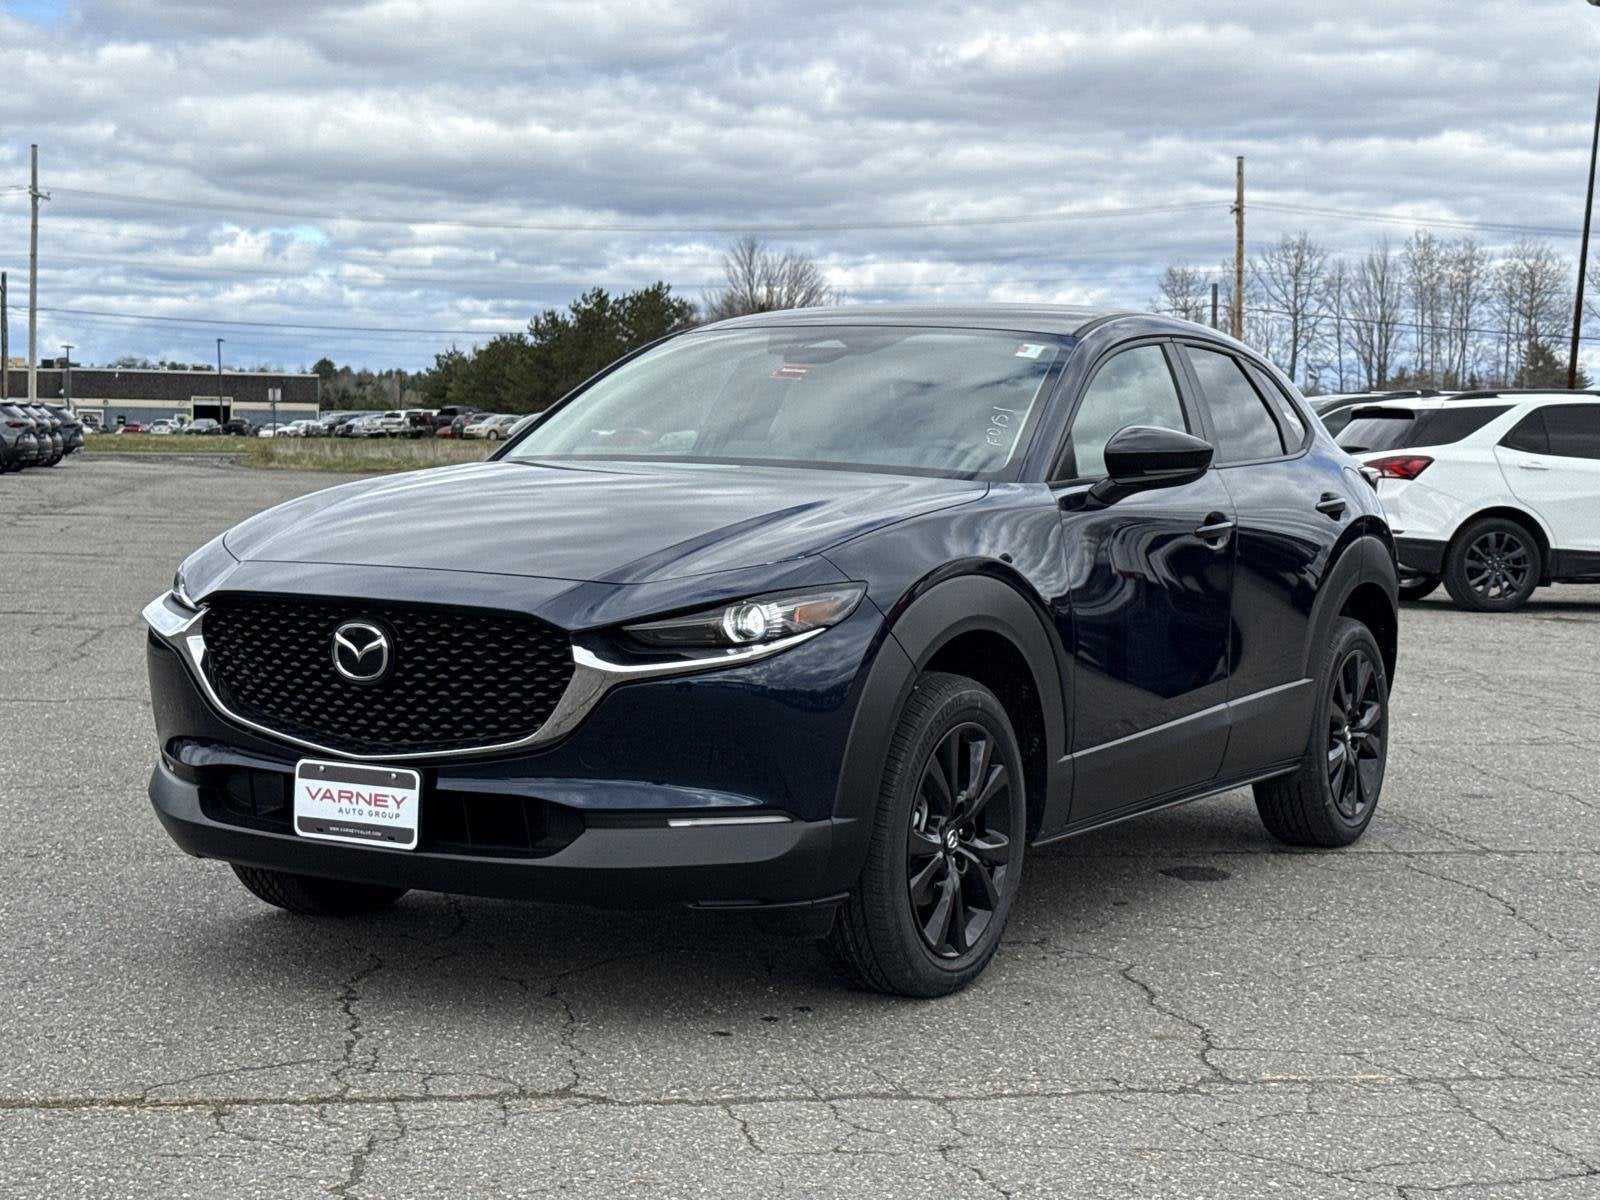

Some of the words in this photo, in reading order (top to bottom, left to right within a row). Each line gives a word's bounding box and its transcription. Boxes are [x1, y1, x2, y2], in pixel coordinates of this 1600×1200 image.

[305, 786, 408, 810] VARNEY
[338, 807, 364, 817] AUTO
[368, 810, 401, 820] GROUP
